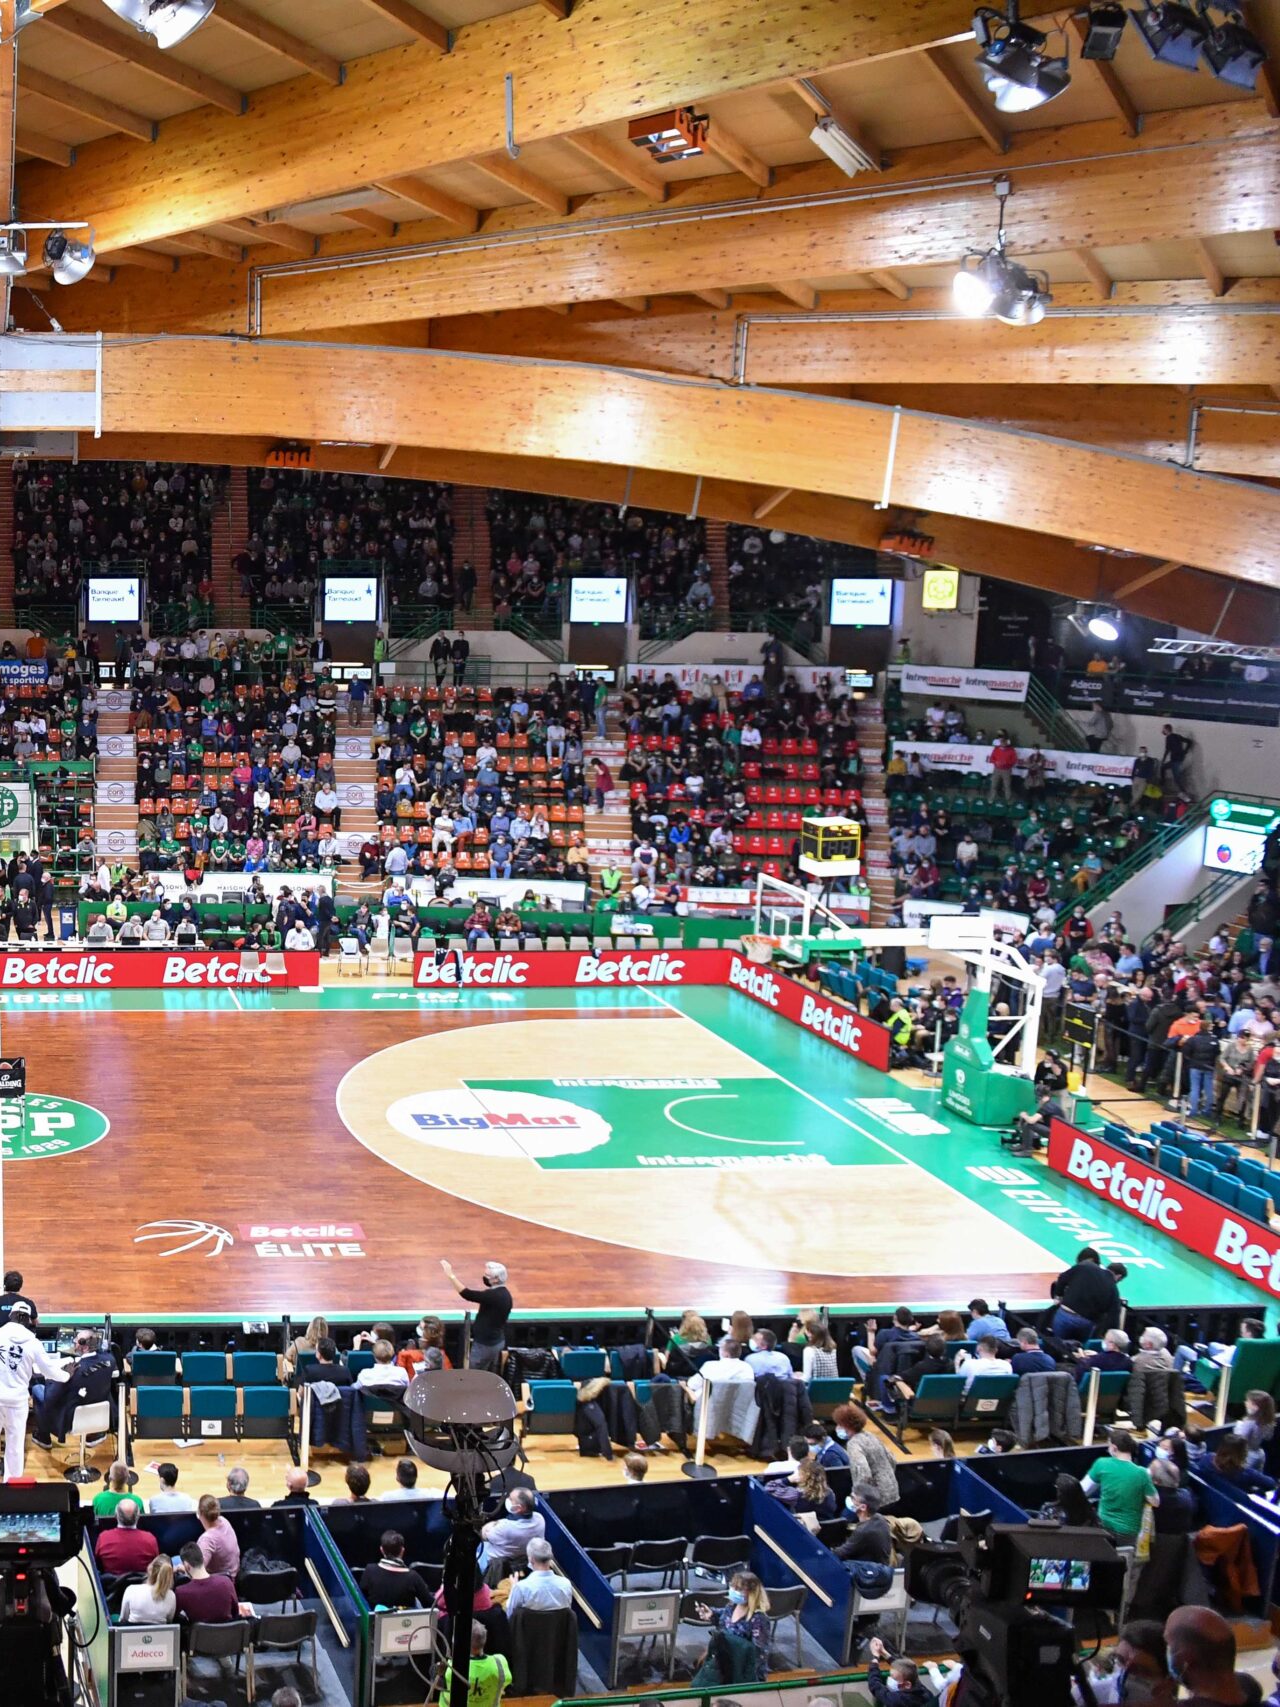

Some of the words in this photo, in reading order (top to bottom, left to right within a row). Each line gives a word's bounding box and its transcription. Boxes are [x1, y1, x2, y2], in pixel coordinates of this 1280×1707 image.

[10, 676, 45, 685] sportive
[107, 788, 124, 796] cora
[2, 956, 114, 984] Betclic
[417, 954, 530, 984] Betclic
[575, 952, 686, 983] Betclic
[729, 956, 780, 1006] Betclic
[801, 994, 862, 1052] Betclic
[410, 1113, 581, 1130] BigMat
[21, 1138, 70, 1154] 1929
[1067, 1138, 1183, 1230] Betclic
[248, 1226, 354, 1238] Betclic
[254, 1239, 366, 1257] ÉLITE
[130, 1649, 163, 1658] Adecco
